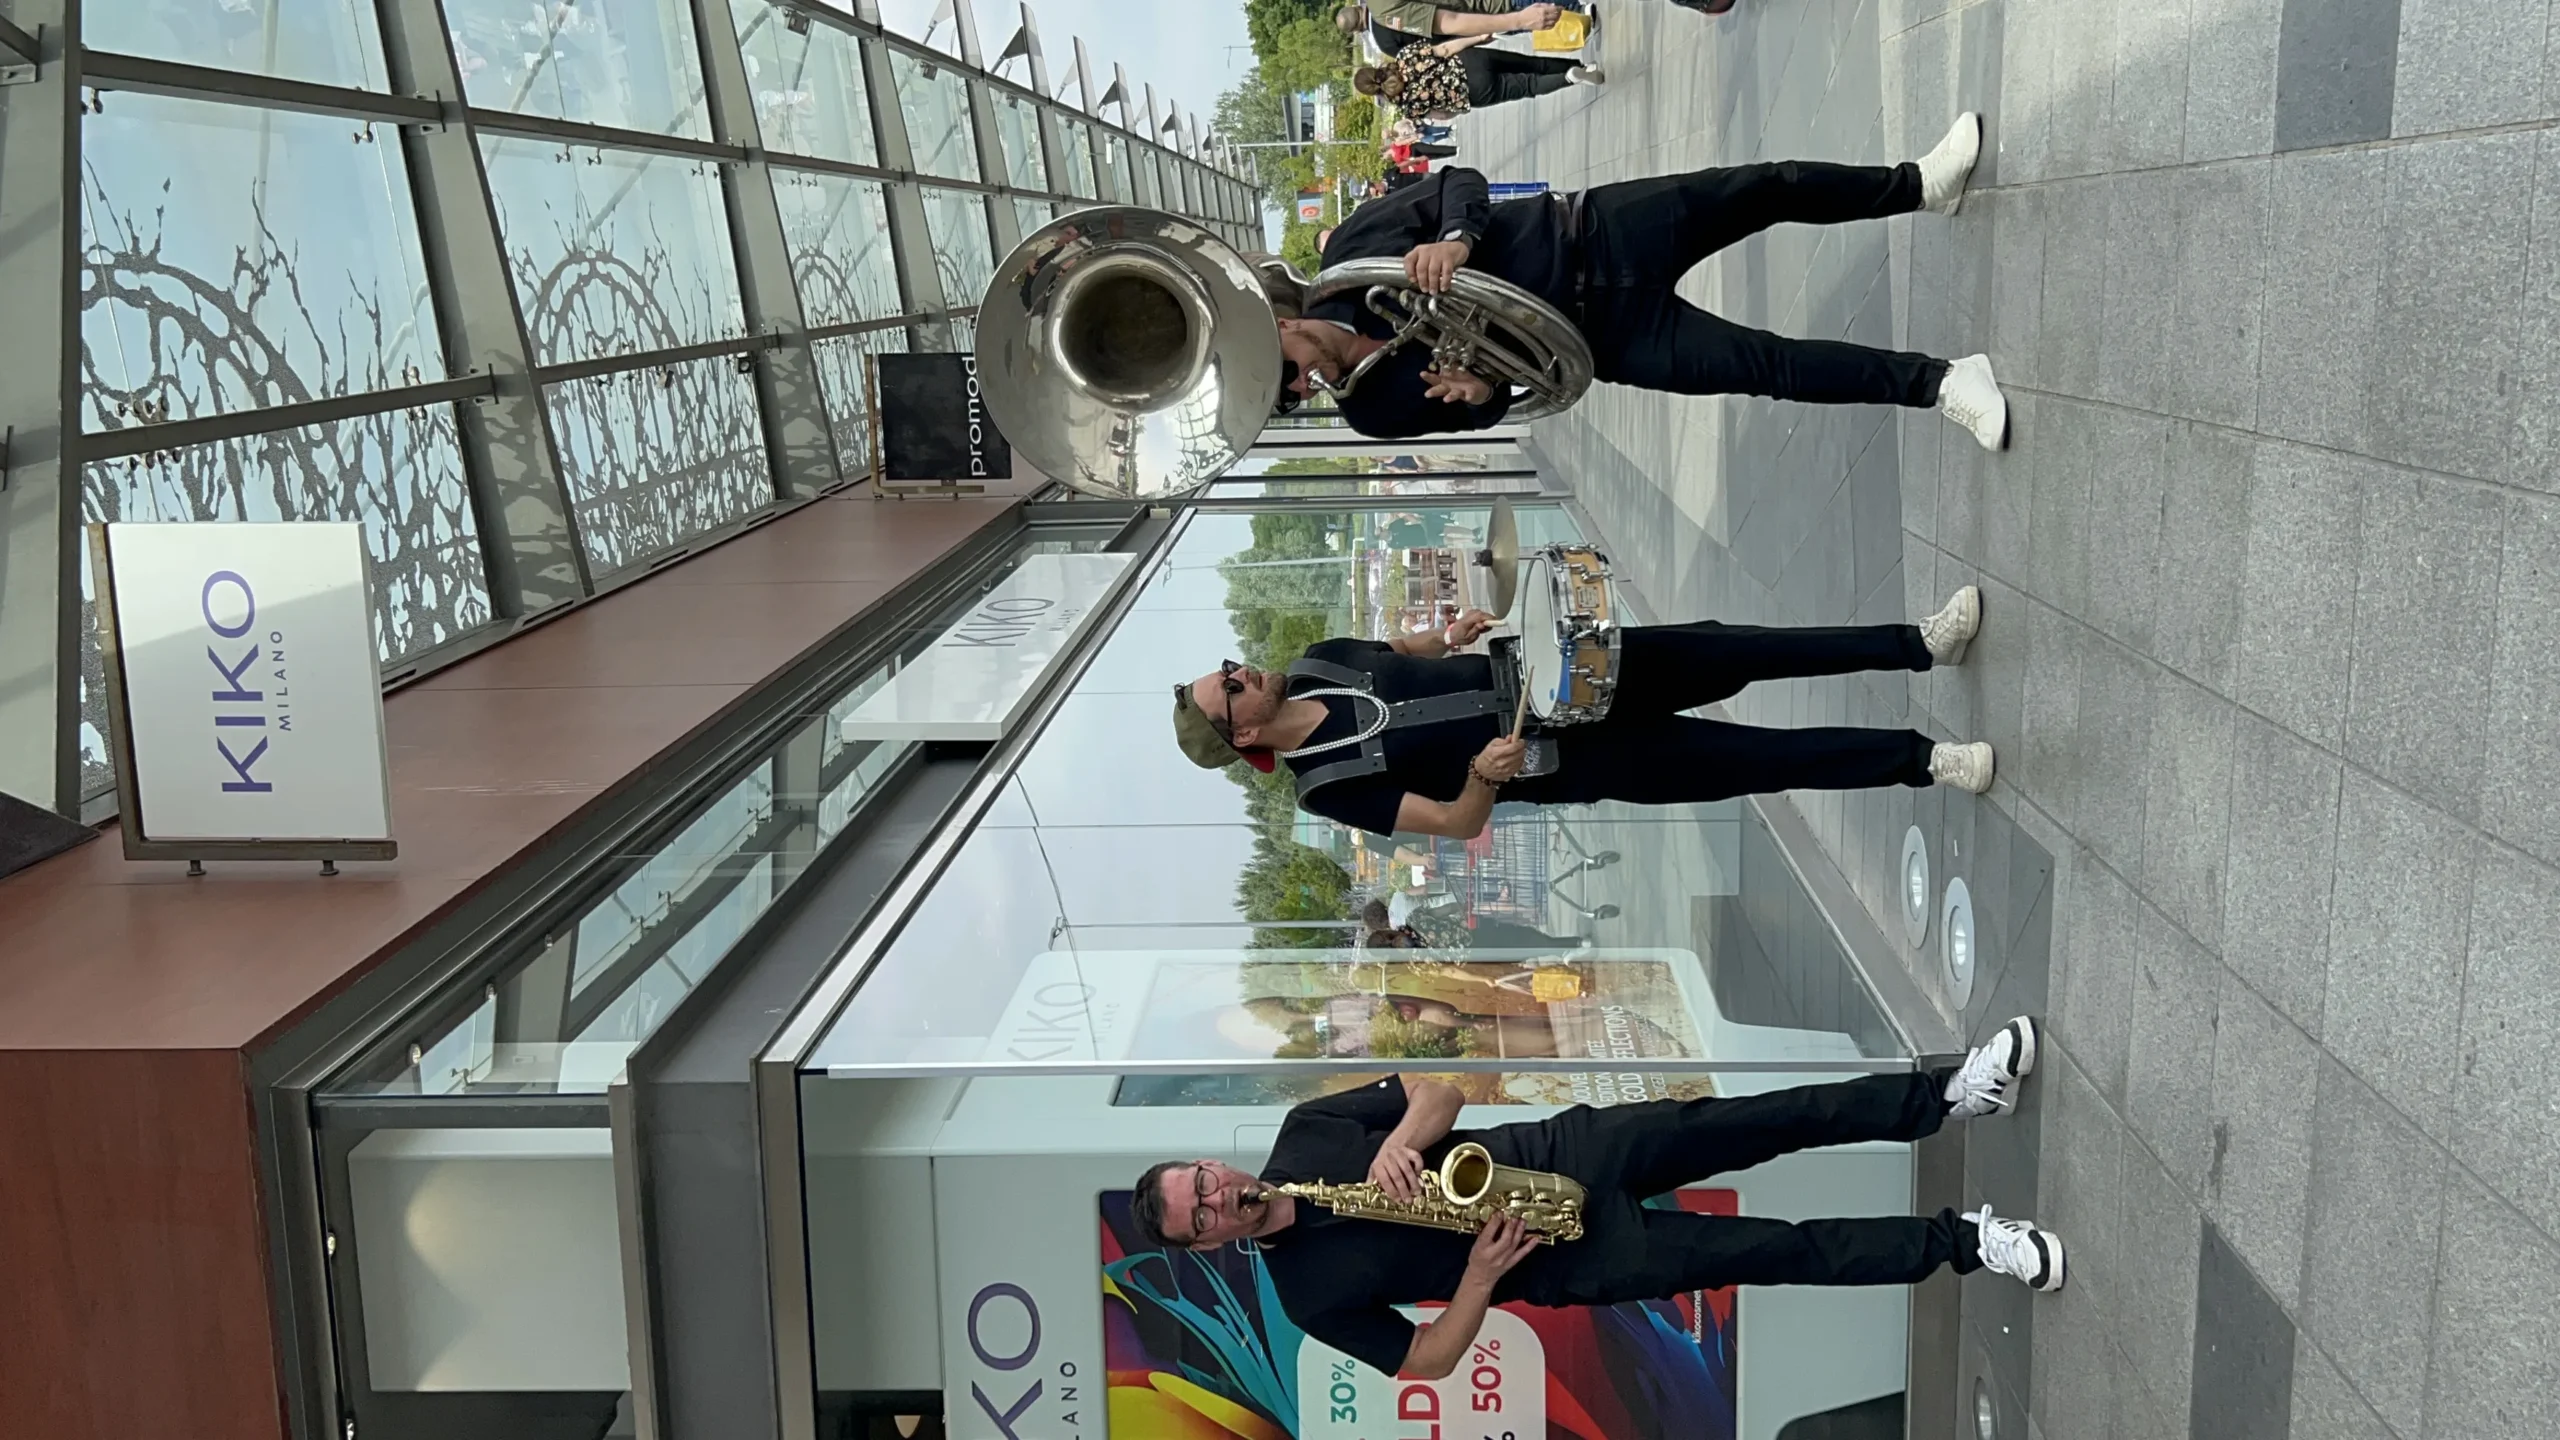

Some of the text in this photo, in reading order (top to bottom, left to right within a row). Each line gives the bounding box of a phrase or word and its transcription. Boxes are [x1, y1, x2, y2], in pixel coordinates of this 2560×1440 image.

[962, 356, 987, 476] promod
[942, 598, 1055, 647] KIKO
[202, 570, 272, 792] KIKO
[270, 631, 291, 731] MILANO
[1569, 1072, 1591, 1103] NOUVEL
[1582, 1039, 1618, 1102] EDITION MITÉE
[1600, 1005, 1648, 1103] GOLD EFLECTIONS
[1692, 1290, 1702, 1344] kikocosmet
[1060, 1362, 1080, 1440] ANO
[1330, 1360, 1356, 1424] 30%
[1471, 1340, 1502, 1413] 50%
